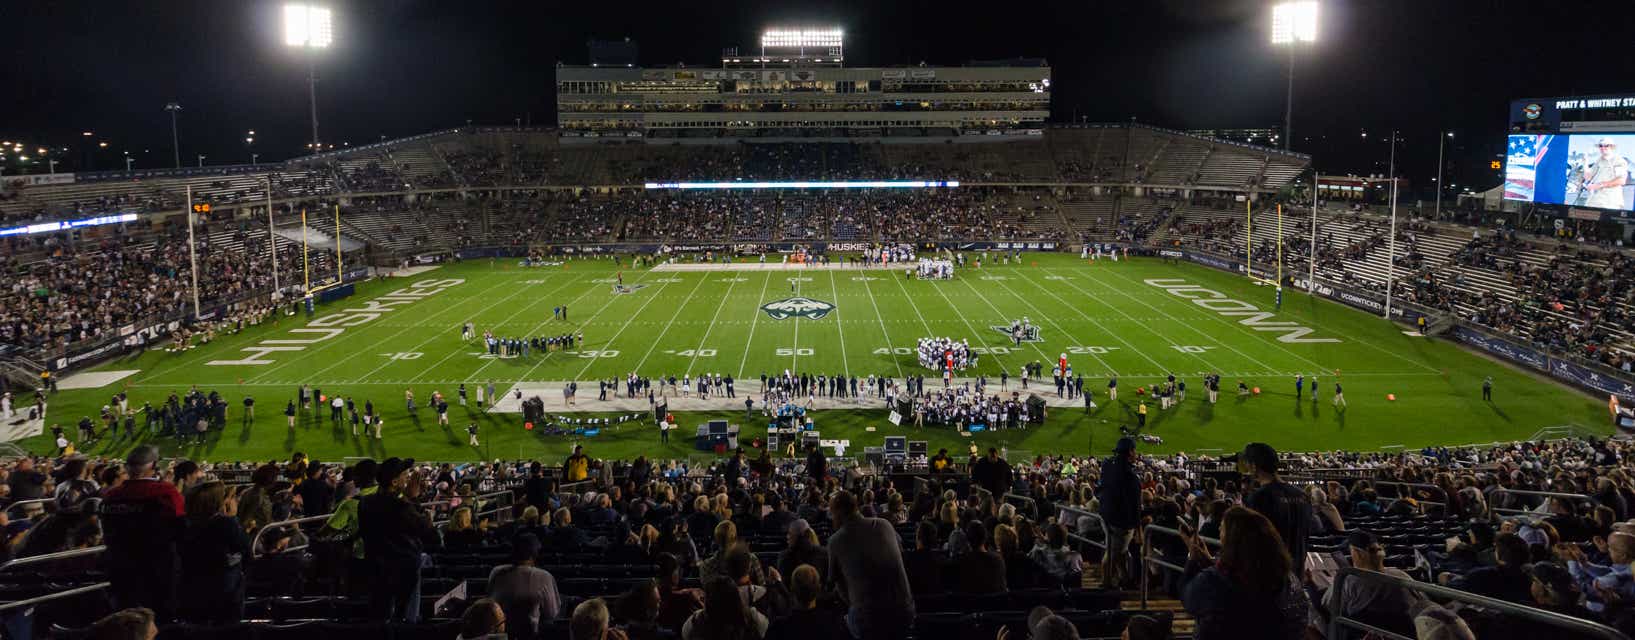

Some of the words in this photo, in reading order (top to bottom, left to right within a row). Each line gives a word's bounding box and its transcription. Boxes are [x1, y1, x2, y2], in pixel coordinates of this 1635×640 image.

[1555, 100, 1578, 109] PRATT
[1579, 101, 1586, 109] &
[1588, 98, 1622, 108] WHITNEY
[1143, 278, 1343, 344] UCONN
[204, 278, 465, 366] HUSKIES
[578, 350, 620, 358] 30
[676, 349, 718, 357] 40
[775, 348, 815, 356] 50
[872, 347, 913, 355] 40
[1066, 346, 1110, 354] 20
